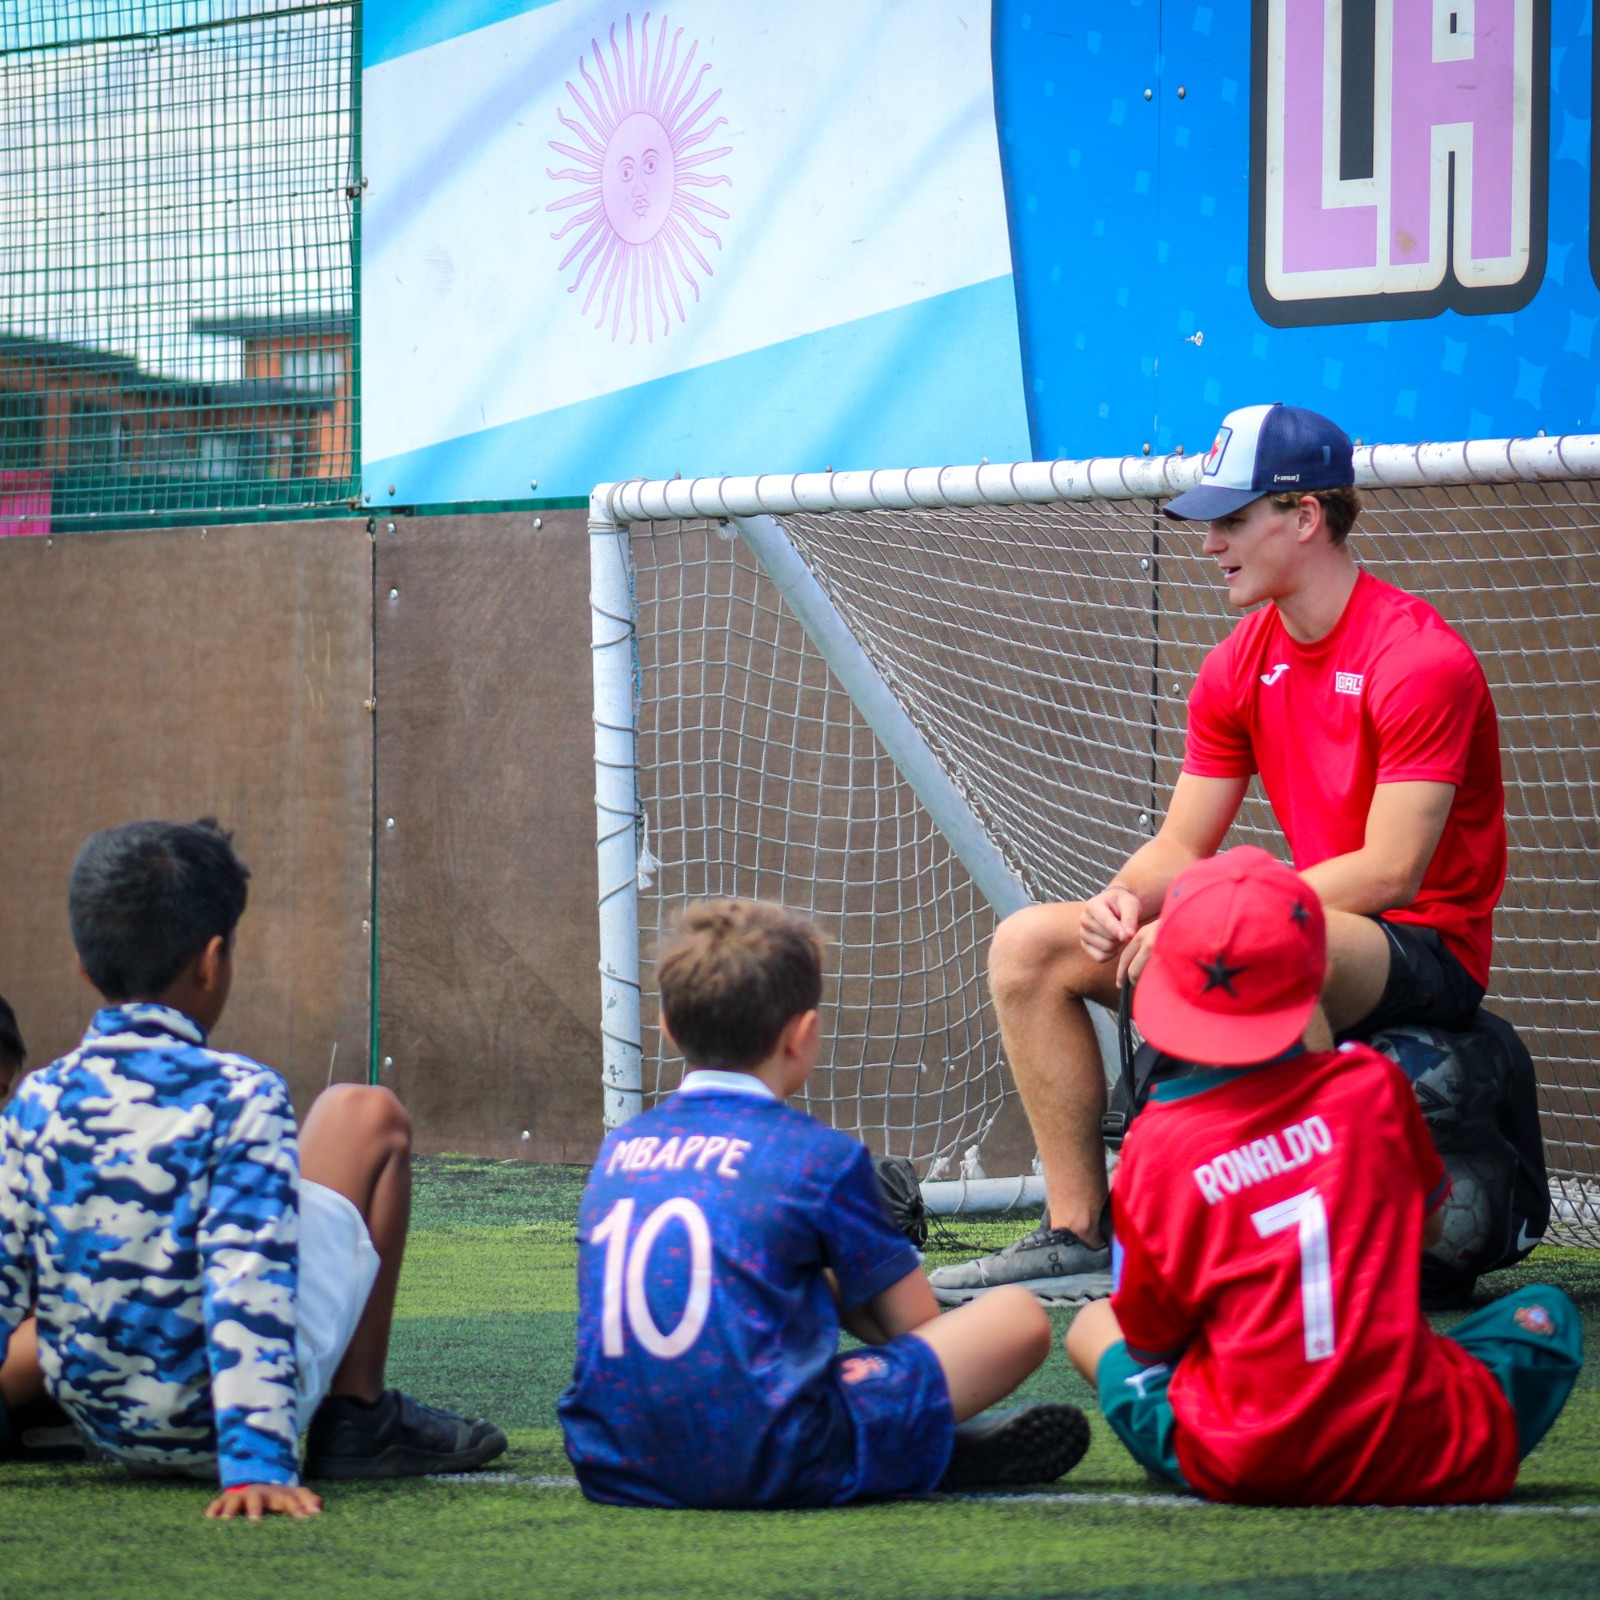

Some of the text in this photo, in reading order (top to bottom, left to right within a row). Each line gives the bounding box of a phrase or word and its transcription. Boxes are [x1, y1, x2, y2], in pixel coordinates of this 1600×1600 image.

[1265, 0, 1531, 301] LA
[605, 1135, 752, 1178] MBAPPE
[1193, 1114, 1333, 1206] RONALDO
[590, 1197, 712, 1358] 10
[1250, 1186, 1335, 1362] 7
